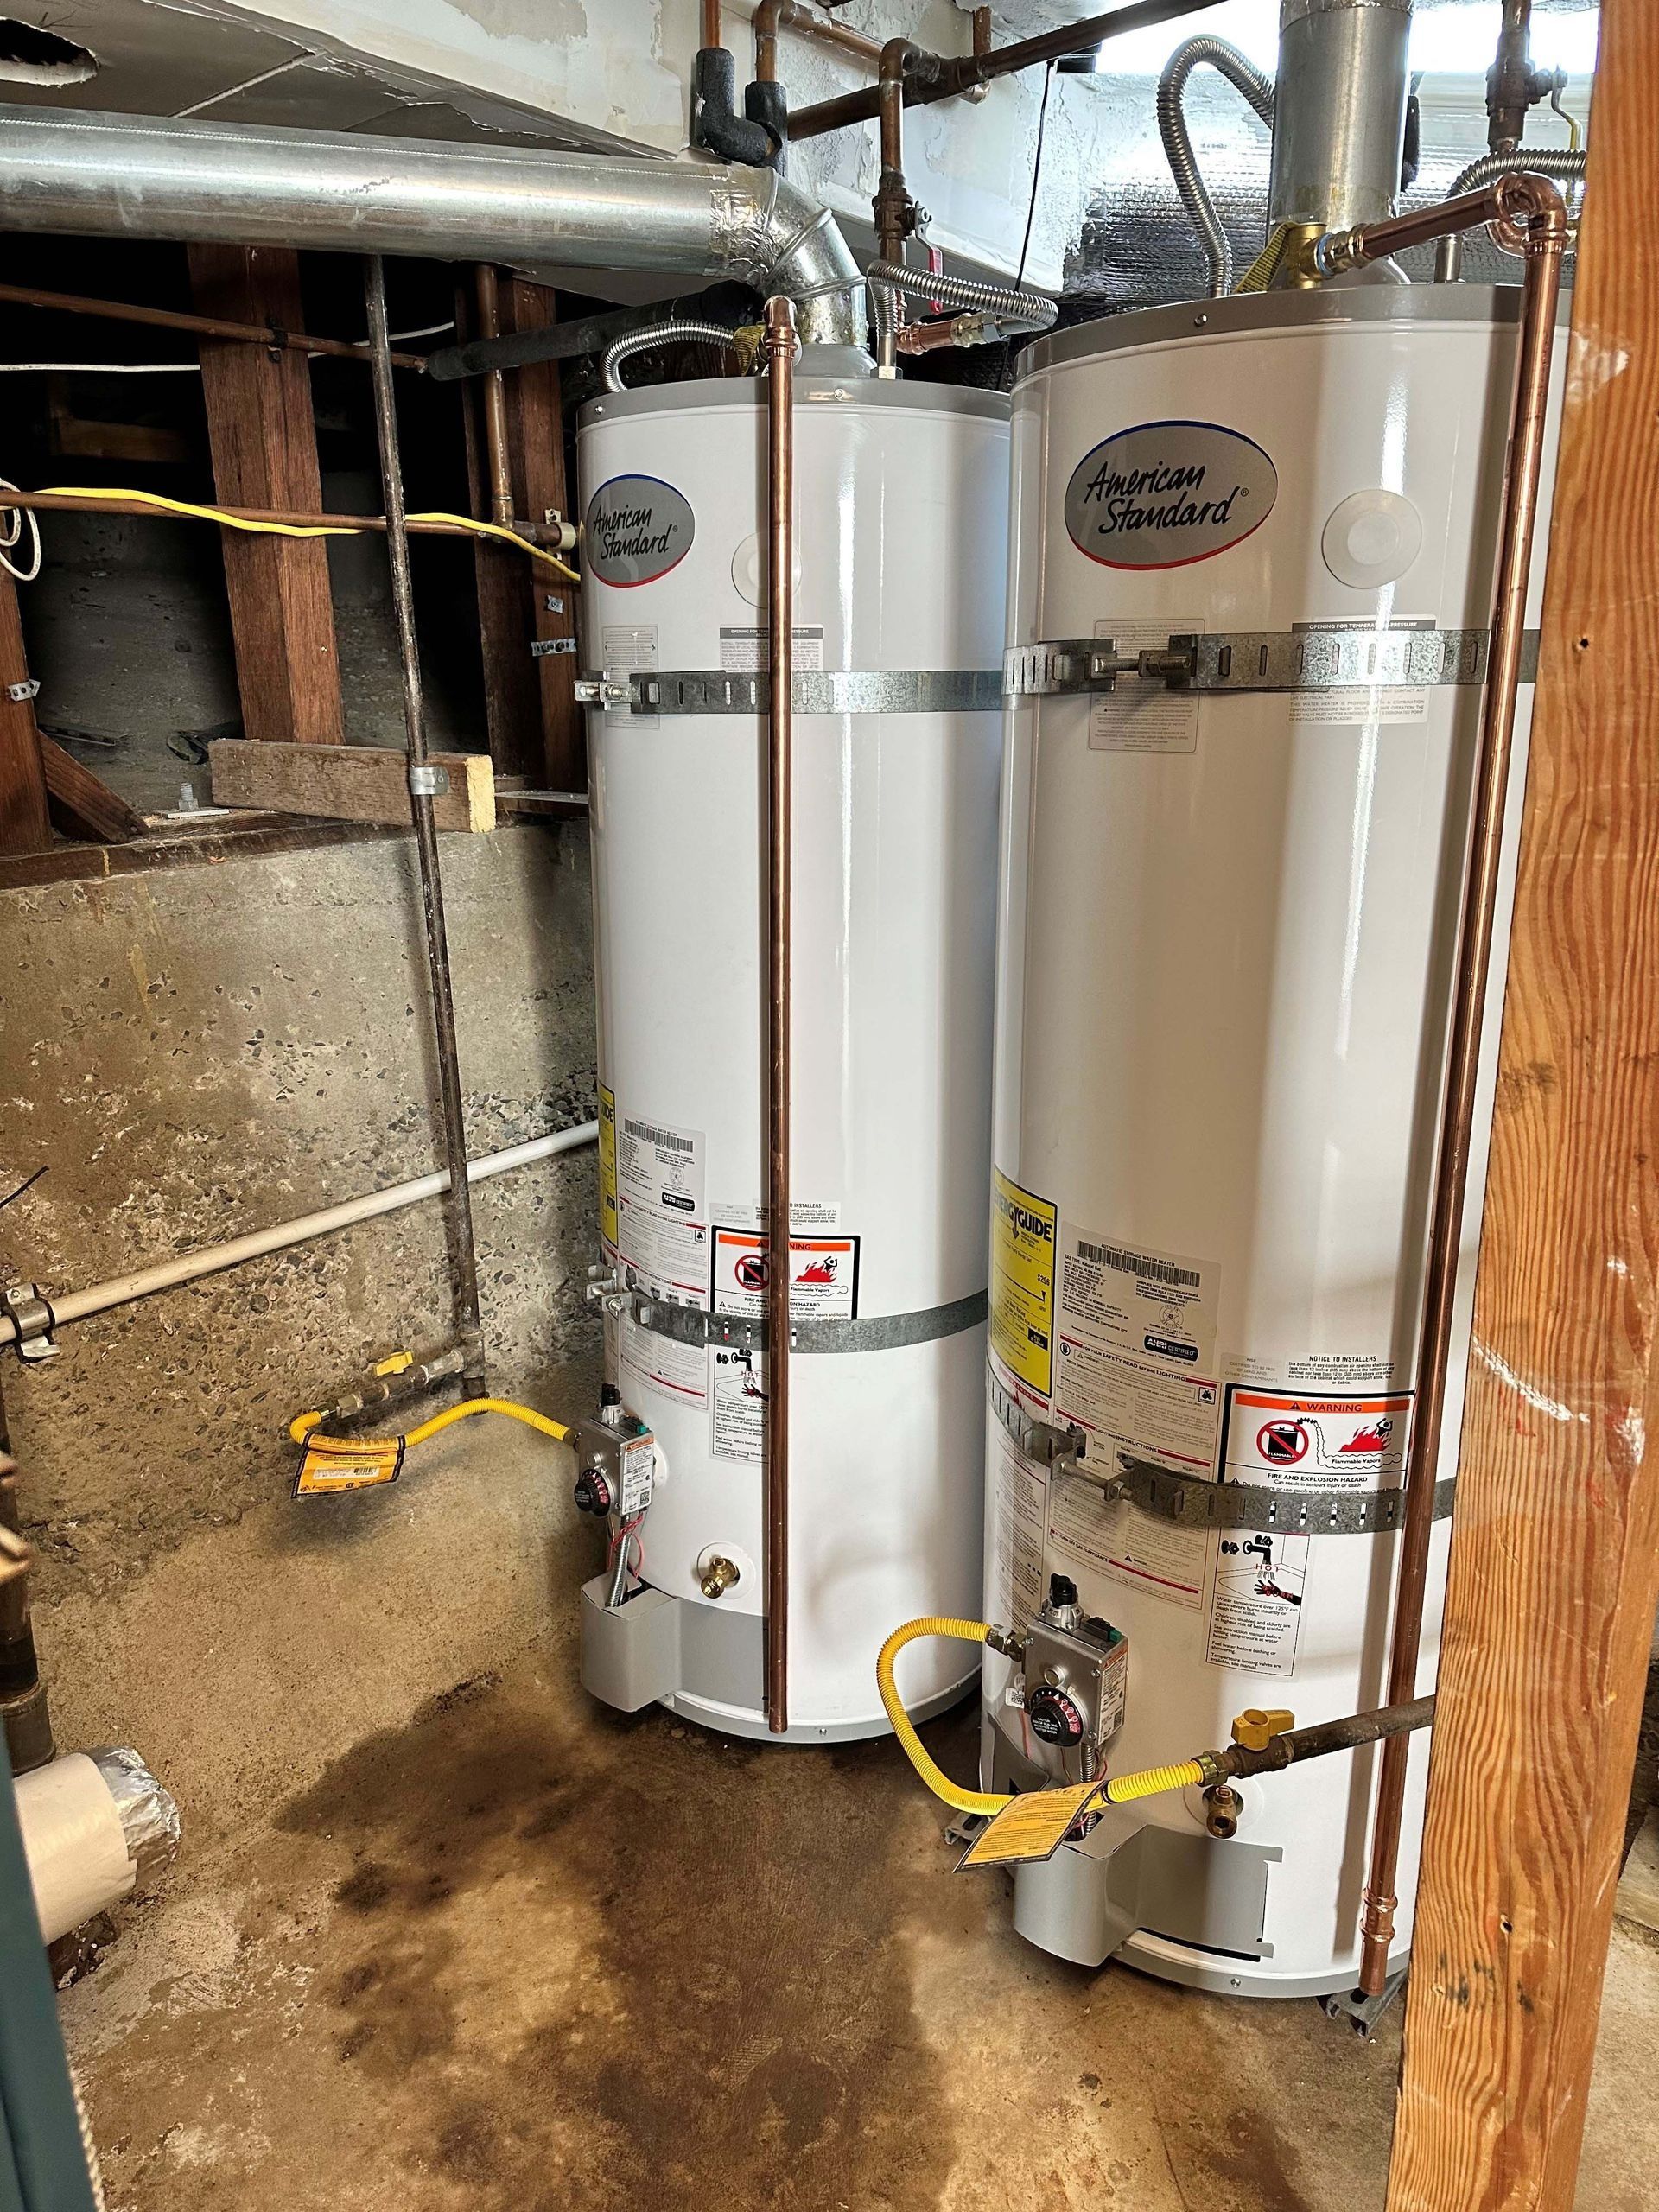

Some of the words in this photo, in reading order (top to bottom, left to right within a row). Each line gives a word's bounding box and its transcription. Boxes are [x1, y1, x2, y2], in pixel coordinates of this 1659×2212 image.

[1084, 460, 1206, 504] American
[1098, 486, 1240, 534] Standard
[593, 504, 652, 537] American
[600, 524, 672, 559] Standard
[1101, 1243, 1123, 1254] AUTOMATIC
[1124, 1250, 1141, 1259] STORAGE
[1168, 1345, 1194, 1356] CERTIFIED
[1102, 1352, 1122, 1363] SAFETY
[1123, 1360, 1138, 1368] READ
[1139, 1365, 1156, 1374] BEFORE
[1156, 1370, 1187, 1382] LIGHTING
[1307, 1403, 1363, 1412] WARNING
[1116, 1435, 1157, 1452] INSTRUCTIONS
[1255, 1563, 1281, 1572] HOT
[1233, 1599, 1262, 1608] temperature
[1215, 1612, 1236, 1621] Children,
[1223, 1626, 1248, 1635] instruction
[1229, 1632, 1258, 1641] temperature
[1211, 1645, 1236, 1654] showering.
[1253, 1648, 1270, 1656] bathing
[1211, 1652, 1240, 1662] Temperature
[1242, 1658, 1258, 1666] limiting
